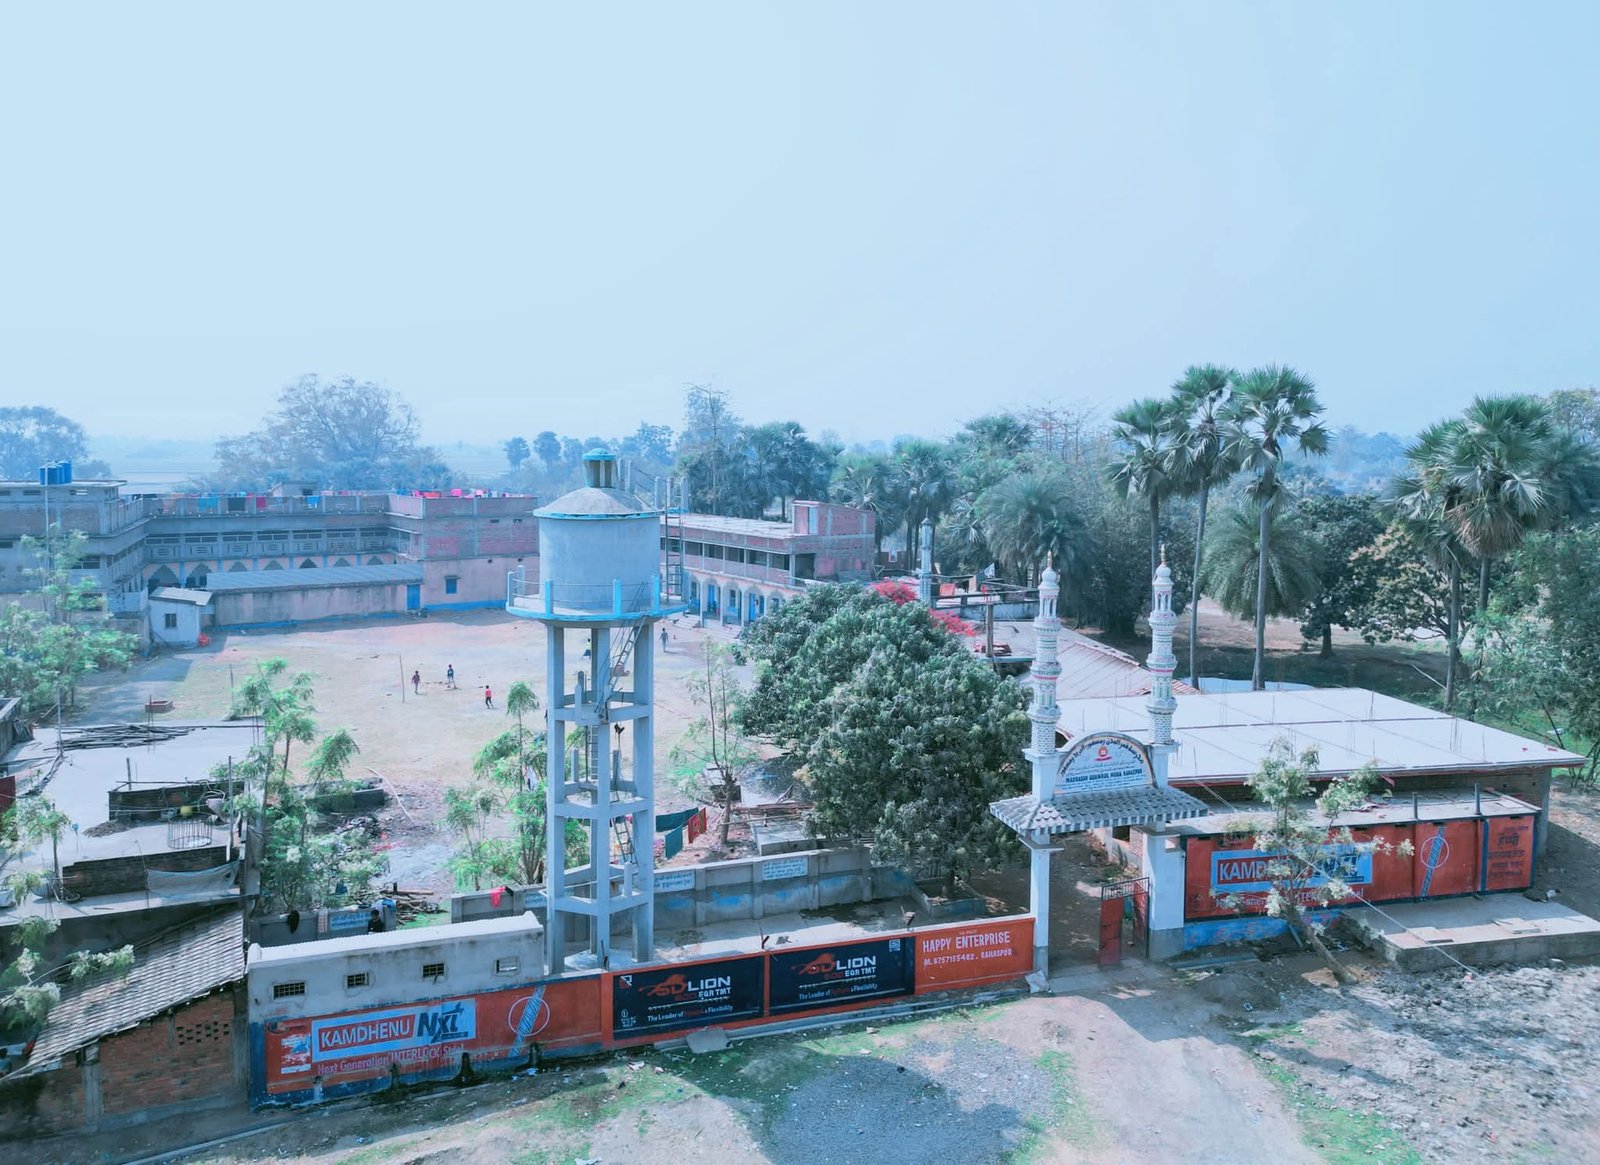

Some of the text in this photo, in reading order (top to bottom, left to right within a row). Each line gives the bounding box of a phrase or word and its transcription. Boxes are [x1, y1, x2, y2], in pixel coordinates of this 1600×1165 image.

[922, 931, 1011, 953] HAPPY ENTERPRISE
[836, 955, 876, 971] LION
[861, 966, 877, 974] TMT
[687, 975, 731, 992] LION
[714, 986, 732, 995] TMT
[321, 1018, 411, 1048] KAMDHENU
